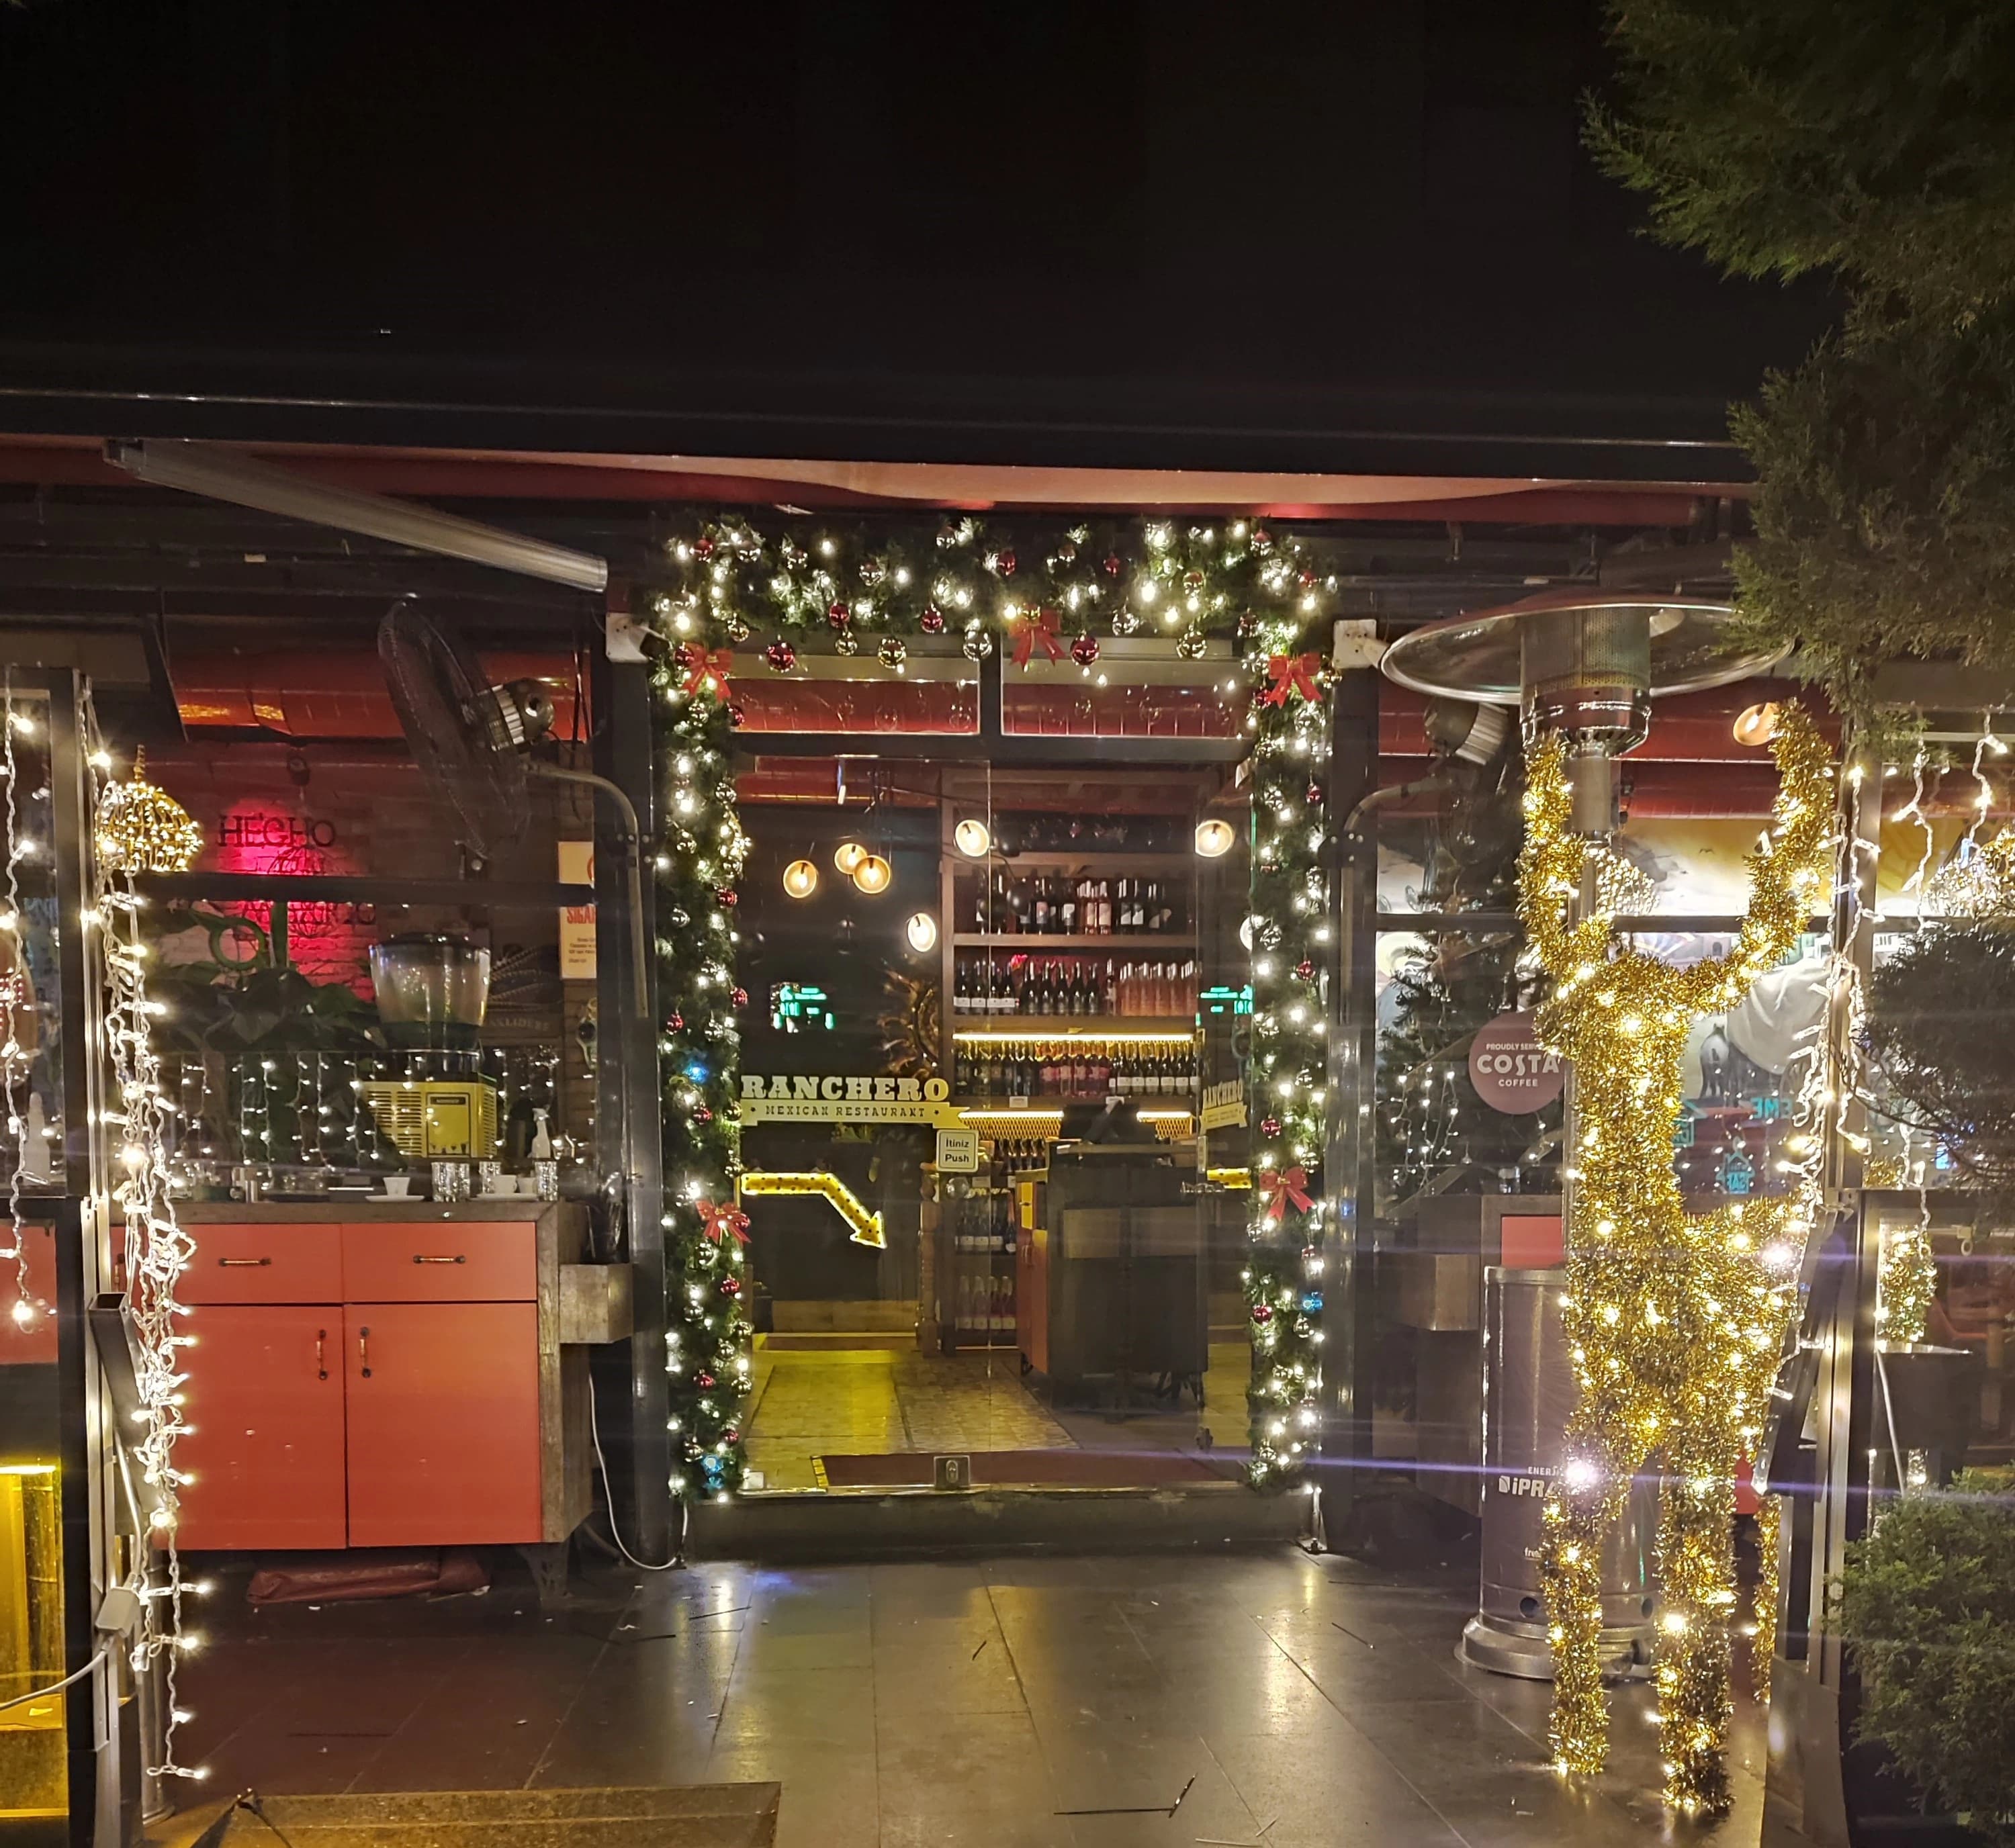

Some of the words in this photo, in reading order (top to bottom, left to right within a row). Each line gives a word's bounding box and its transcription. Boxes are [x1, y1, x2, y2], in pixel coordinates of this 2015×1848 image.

[1477, 1054, 1559, 1076] COSTA
[741, 1075, 949, 1101] RANCHERO
[1498, 1078, 1538, 1087] COFFEE
[766, 1105, 828, 1116] MEXICAN
[836, 1107, 924, 1117] RESTAURANT
[945, 1154, 969, 1162] Push
[1512, 1477, 1556, 1498] iPRA
